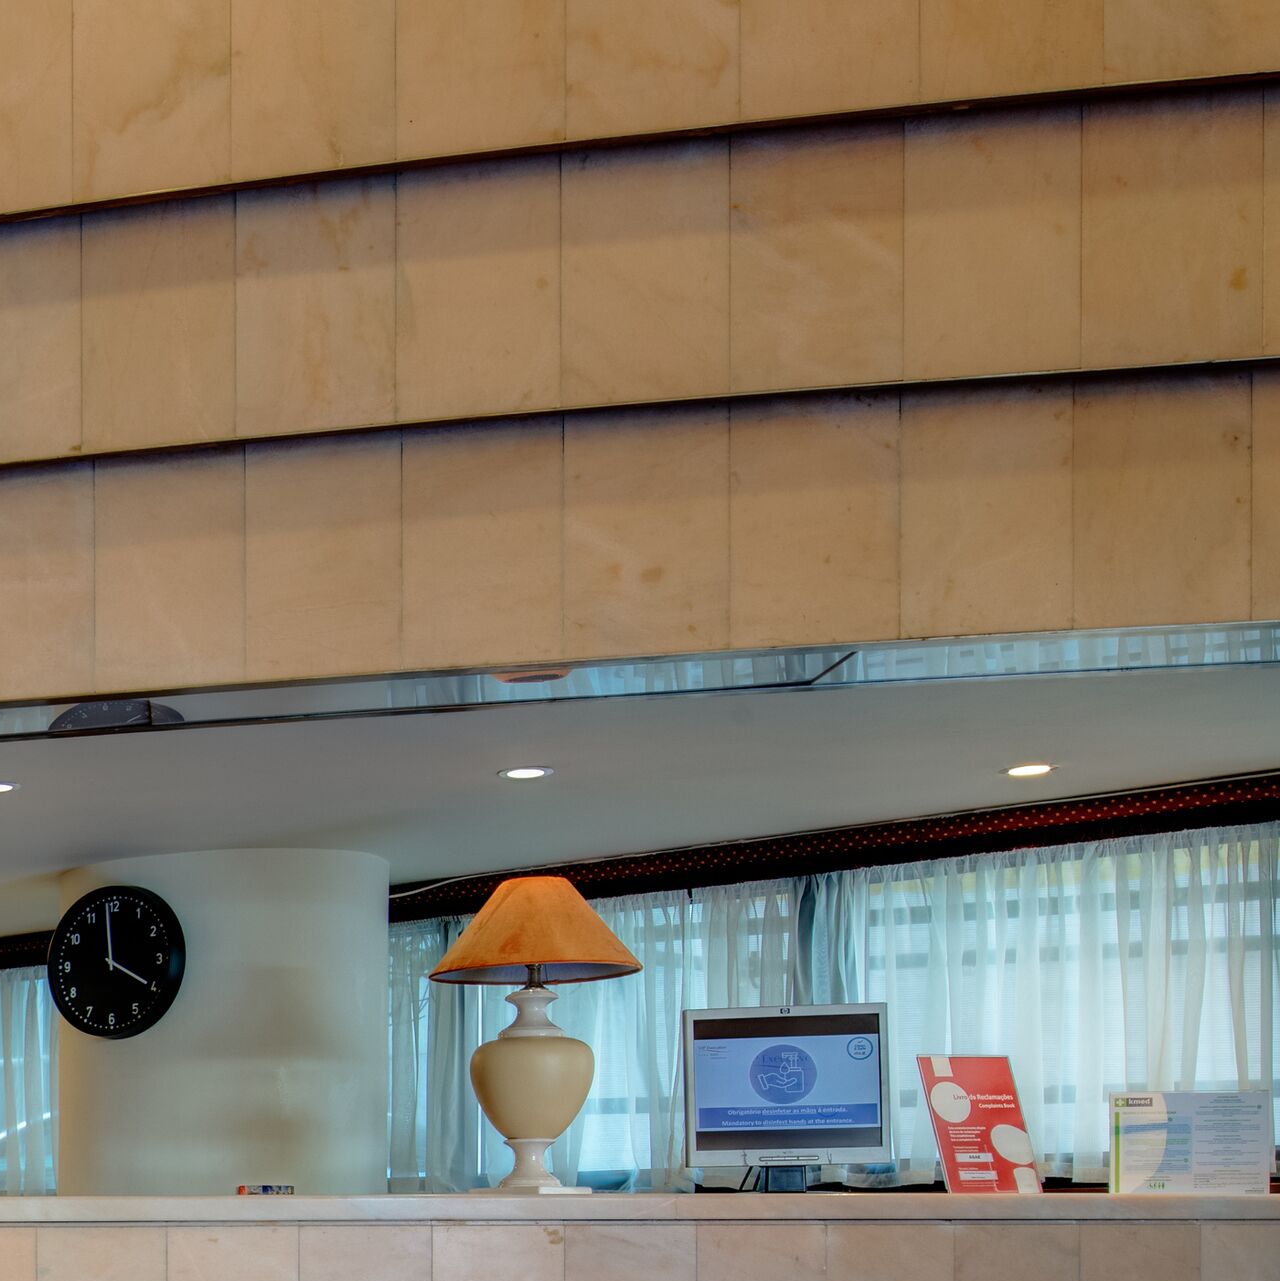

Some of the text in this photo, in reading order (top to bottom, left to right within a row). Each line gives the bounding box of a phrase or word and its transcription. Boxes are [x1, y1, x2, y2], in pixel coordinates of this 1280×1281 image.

[109, 901, 120, 912] 12
[87, 913, 96, 924] 11
[136, 908, 141, 919] 1
[150, 926, 157, 937] 2
[71, 934, 81, 945] 10
[156, 953, 163, 964] 3
[64, 962, 71, 972] 9
[151, 981, 157, 992] 4
[70, 987, 77, 998] 8
[86, 1006, 93, 1018] 7
[132, 1003, 139, 1014] 5
[108, 1013, 115, 1025] 6
